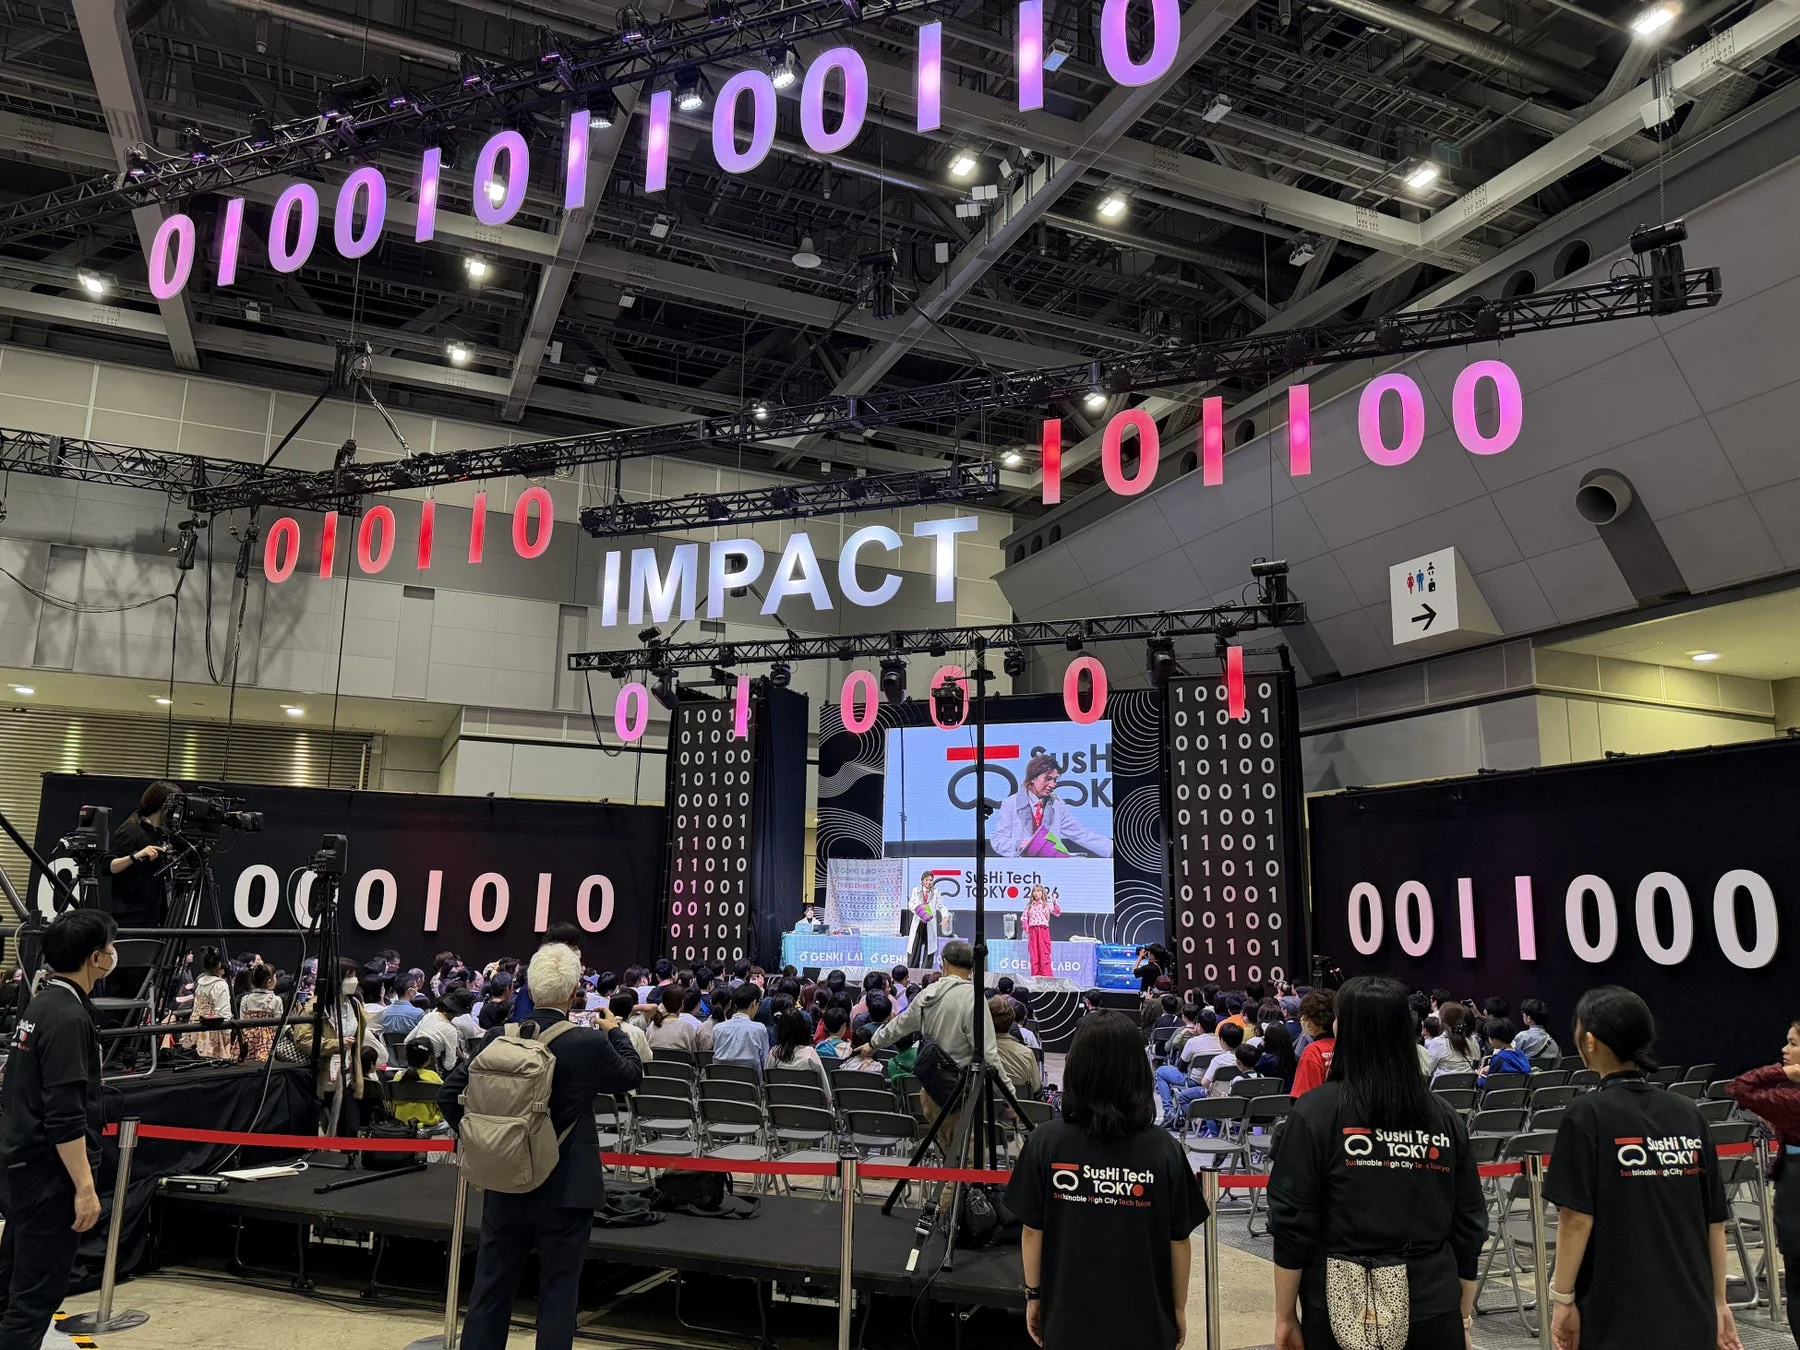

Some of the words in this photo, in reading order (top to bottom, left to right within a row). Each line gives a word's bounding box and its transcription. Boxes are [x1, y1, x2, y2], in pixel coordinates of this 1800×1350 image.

[602, 516, 979, 627] IMPACT
[1007, 871, 1041, 884] Tech
[1023, 886, 1060, 899] 226
[810, 952, 843, 962] GENKI
[1051, 961, 1081, 972] LABO
[1376, 1128, 1413, 1144] SusHi
[1415, 1130, 1450, 1148] Tech
[1646, 1136, 1680, 1151] SusHi
[1680, 1136, 1702, 1150] Tec
[1083, 1165, 1119, 1181] SusHi
[1122, 1168, 1154, 1184] Tech
